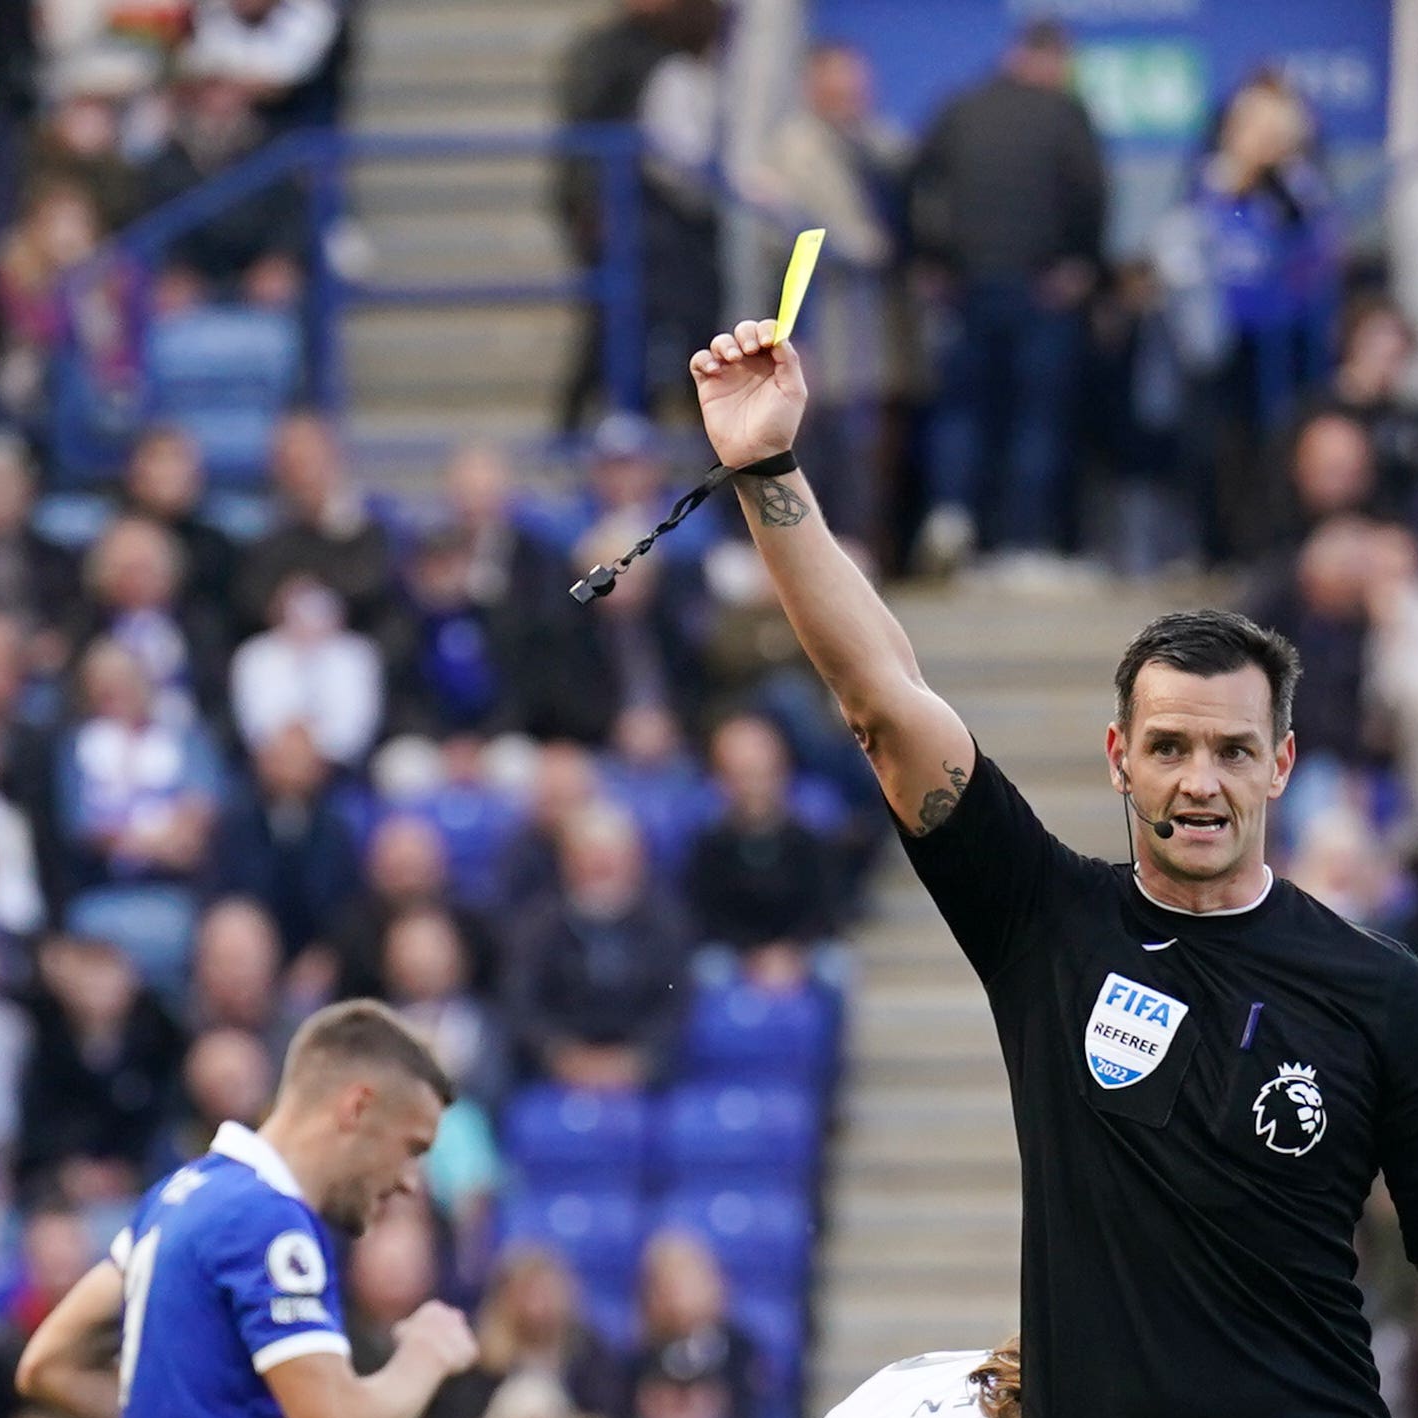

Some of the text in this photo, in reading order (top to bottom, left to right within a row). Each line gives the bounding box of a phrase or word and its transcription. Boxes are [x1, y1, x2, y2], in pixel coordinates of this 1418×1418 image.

[1105, 982, 1171, 1028] FIFA
[1093, 1020, 1159, 1057] REFEREE
[1096, 1058, 1129, 1082] 2022
